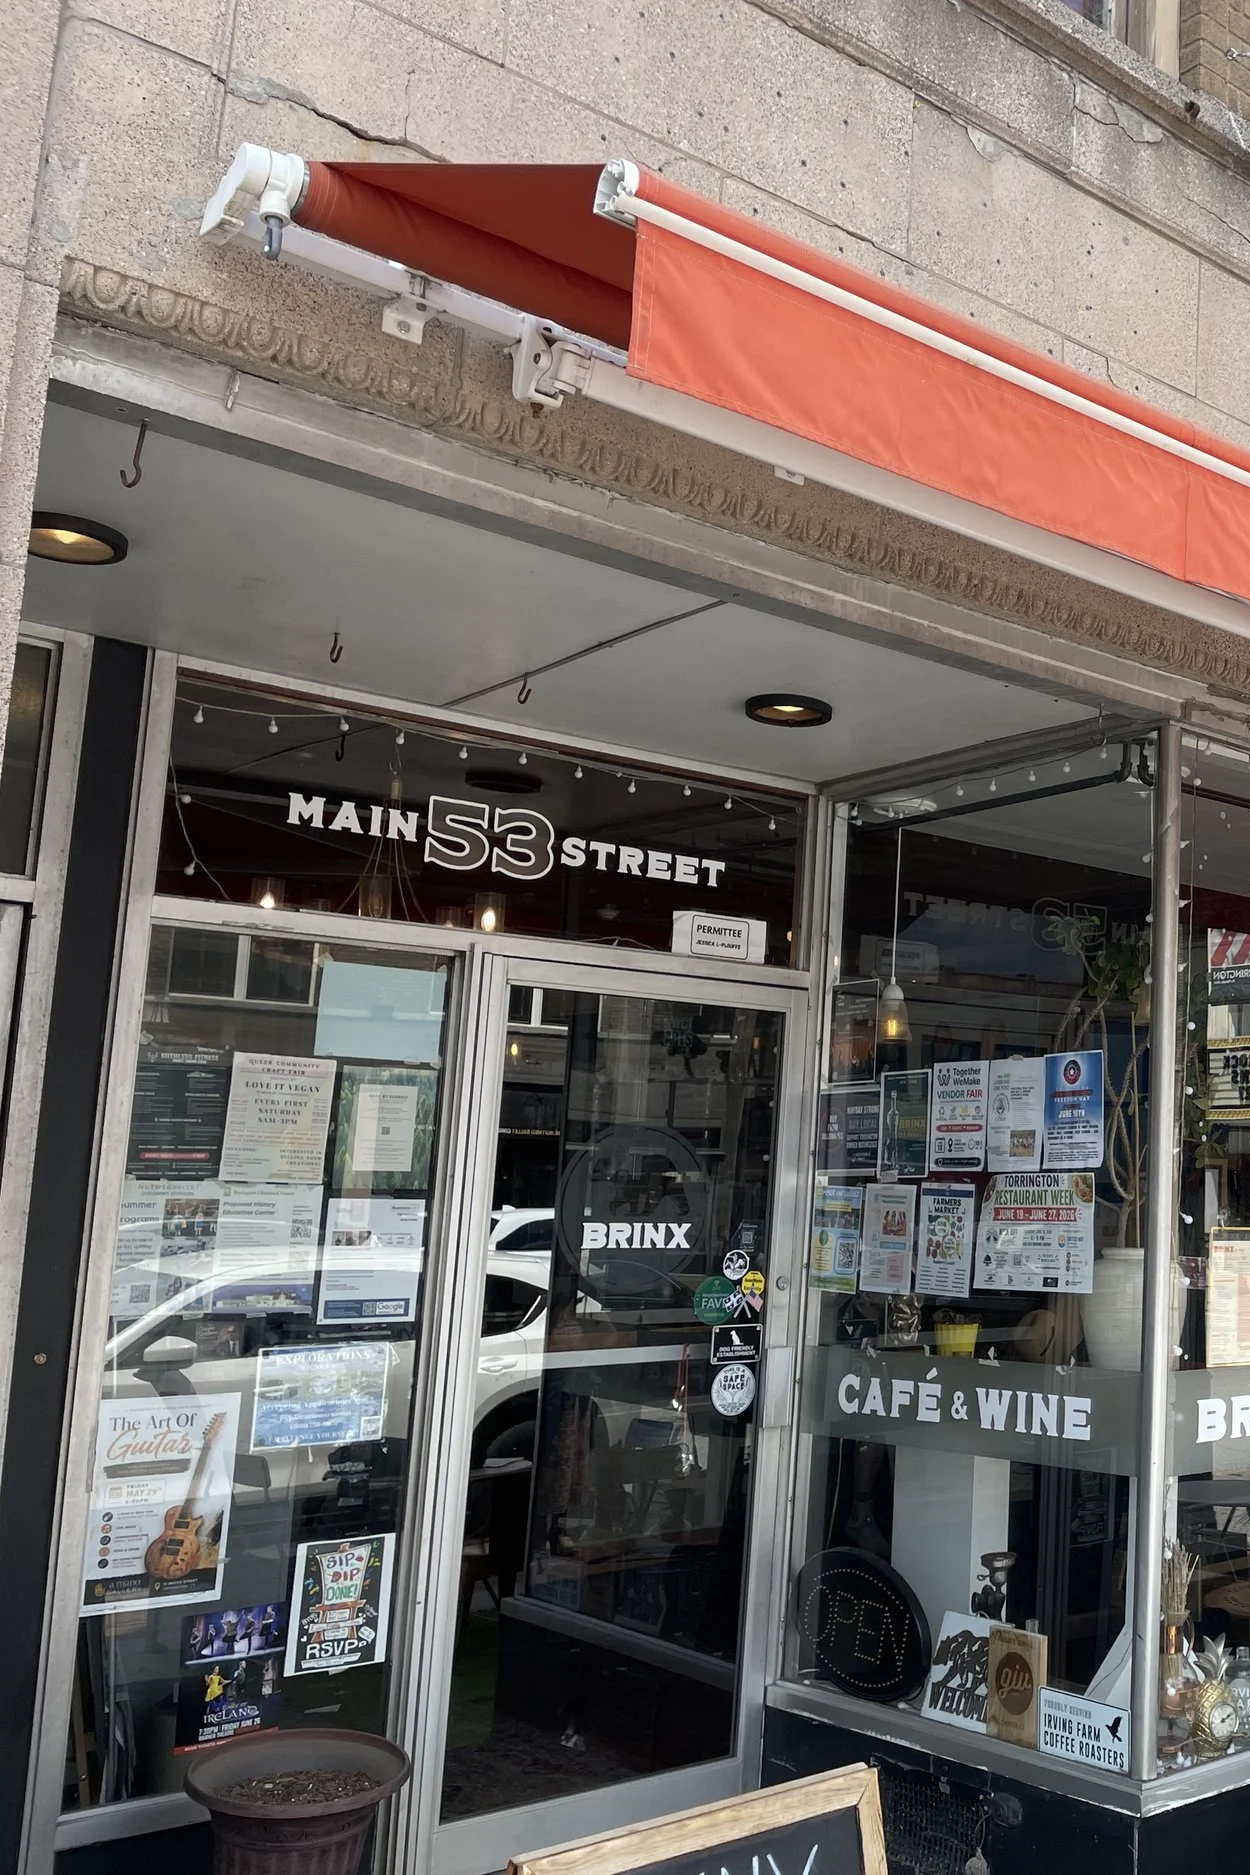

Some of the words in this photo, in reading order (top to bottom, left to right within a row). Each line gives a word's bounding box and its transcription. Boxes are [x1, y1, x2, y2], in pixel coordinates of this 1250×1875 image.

[286, 792, 418, 842] MAIN
[424, 795, 554, 880] 53
[561, 836, 726, 888] STREET
[696, 924, 742, 938] PERMITTEE
[696, 939, 715, 947] JESSICA
[276, 1061, 320, 1069] COMMUNITY
[952, 1067, 981, 1077] Together
[245, 1081, 272, 1091] LOVE
[275, 1083, 285, 1091] IT
[288, 1084, 321, 1093] VEGAN
[953, 1077, 981, 1086] WeMake
[937, 1090, 965, 1100] VENDOR
[966, 1089, 983, 1099] FAIR
[254, 1098, 281, 1106] EVERY
[284, 1100, 309, 1108] FIRST
[258, 1108, 302, 1117] SATURDAY
[1058, 1109, 1073, 1119] JUNE
[1004, 1174, 1060, 1188] TORRINGTON
[932, 1197, 962, 1207] FARMERS
[994, 1189, 1049, 1206] RESTAURANT
[1050, 1189, 1075, 1206] WEEK
[120, 1201, 157, 1209] ummer
[934, 1206, 960, 1215] MARKET
[119, 1216, 160, 1224] rograms
[997, 1209, 1015, 1219] JUNE
[1016, 1209, 1024, 1219] 19
[1029, 1210, 1048, 1220] JUNE
[1048, 1210, 1058, 1221] 27,
[1059, 1210, 1075, 1220] 2026
[580, 1222, 692, 1250] BRINX
[377, 1302, 404, 1312] Google
[276, 1351, 371, 1365] EXPLORATIONS
[723, 1374, 745, 1383] SAFE
[722, 1383, 745, 1391] SPACE
[838, 1367, 942, 1424] CAFÉ
[950, 1389, 968, 1421] &
[975, 1387, 1092, 1441] WINE
[110, 1416, 141, 1432] The
[146, 1415, 171, 1430] Art
[176, 1412, 198, 1428] Of
[106, 1429, 193, 1462] Guitar
[126, 1489, 145, 1498] MAY
[326, 1552, 355, 1569] SIP
[330, 1567, 360, 1583] DIP
[325, 1582, 359, 1602] DONE!
[306, 1639, 358, 1659] RSVP
[203, 1705, 260, 1724] IRELAND
[221, 1721, 241, 1732] FRIDAY
[240, 1718, 253, 1728] JUNE
[1043, 1713, 1073, 1736] IRVING
[1076, 1722, 1101, 1743] FARM
[1043, 1730, 1075, 1754] COFFEE
[1078, 1740, 1125, 1769] ROASTERS
